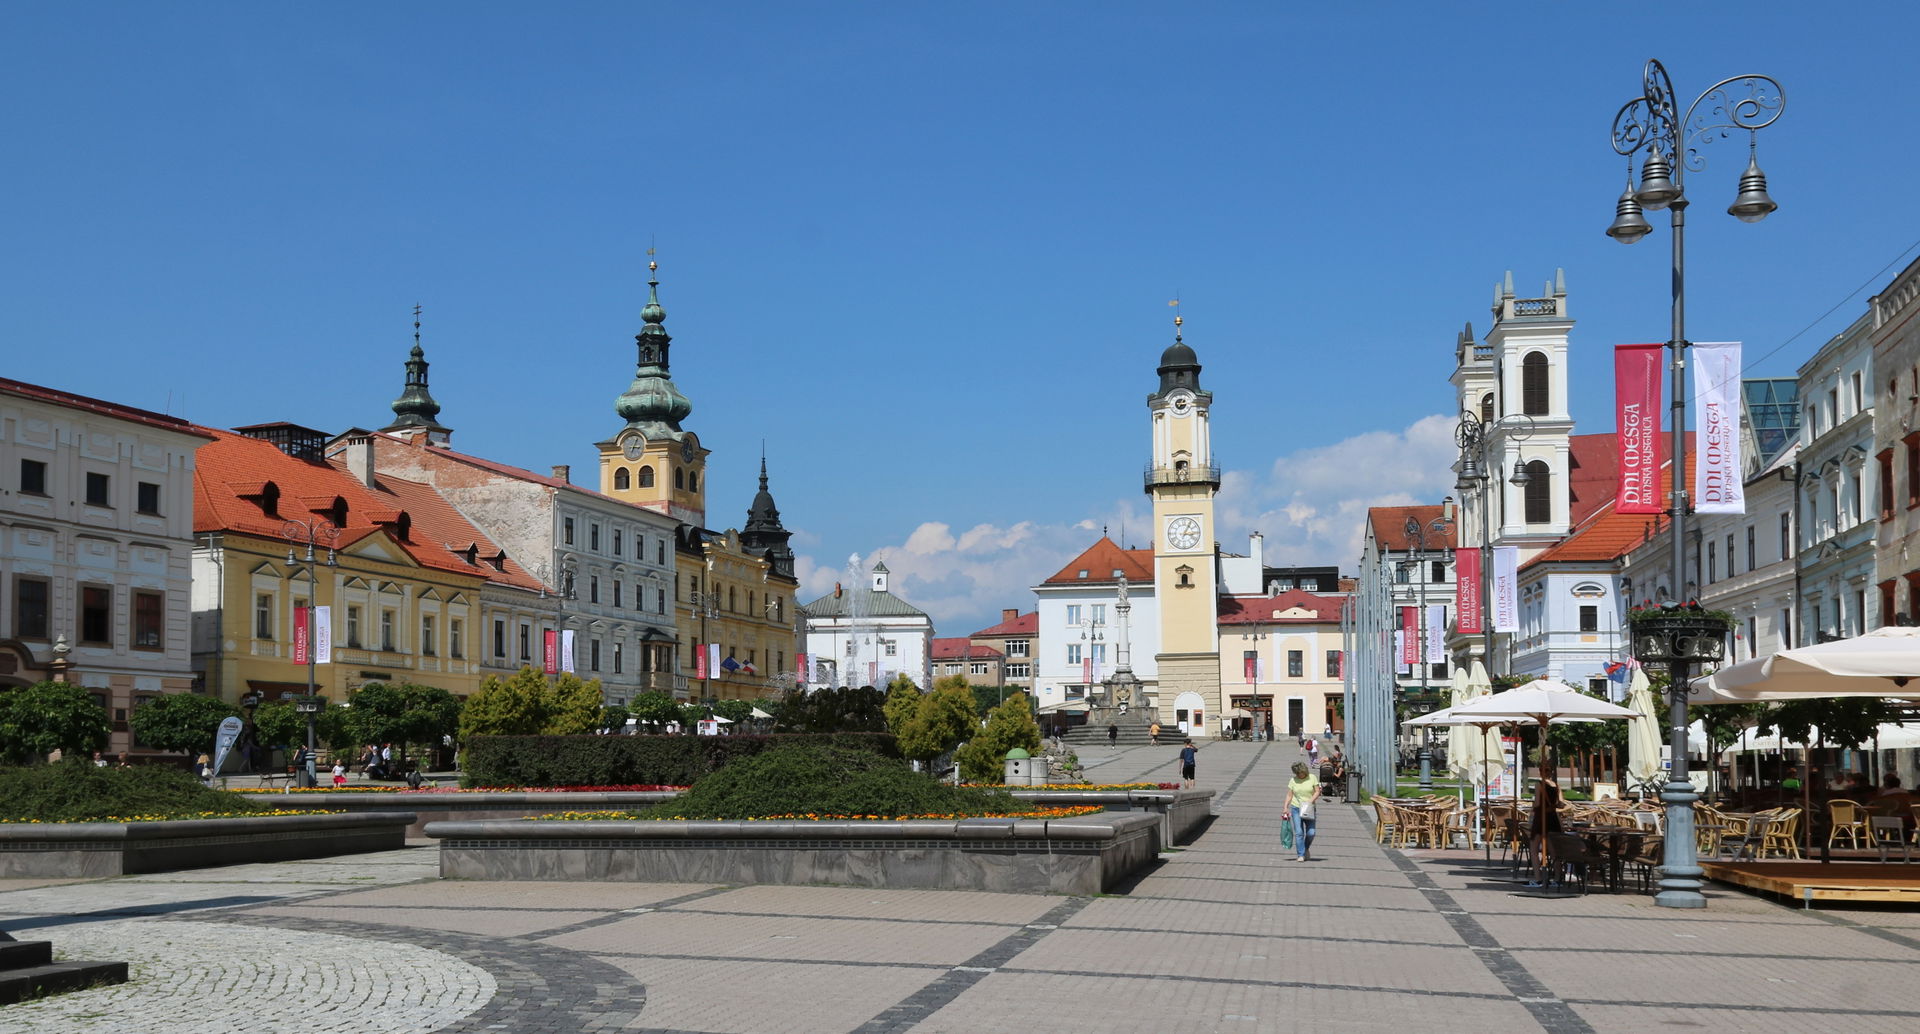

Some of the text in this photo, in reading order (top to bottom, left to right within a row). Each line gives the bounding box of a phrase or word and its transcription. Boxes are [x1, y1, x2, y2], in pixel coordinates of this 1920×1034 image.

[1624, 403, 1640, 504] DNI MESTA
[1643, 416, 1653, 464] BYSTRICA
[1706, 402, 1721, 503] DNI MESTA
[1461, 576, 1470, 629] DNI MESTA
